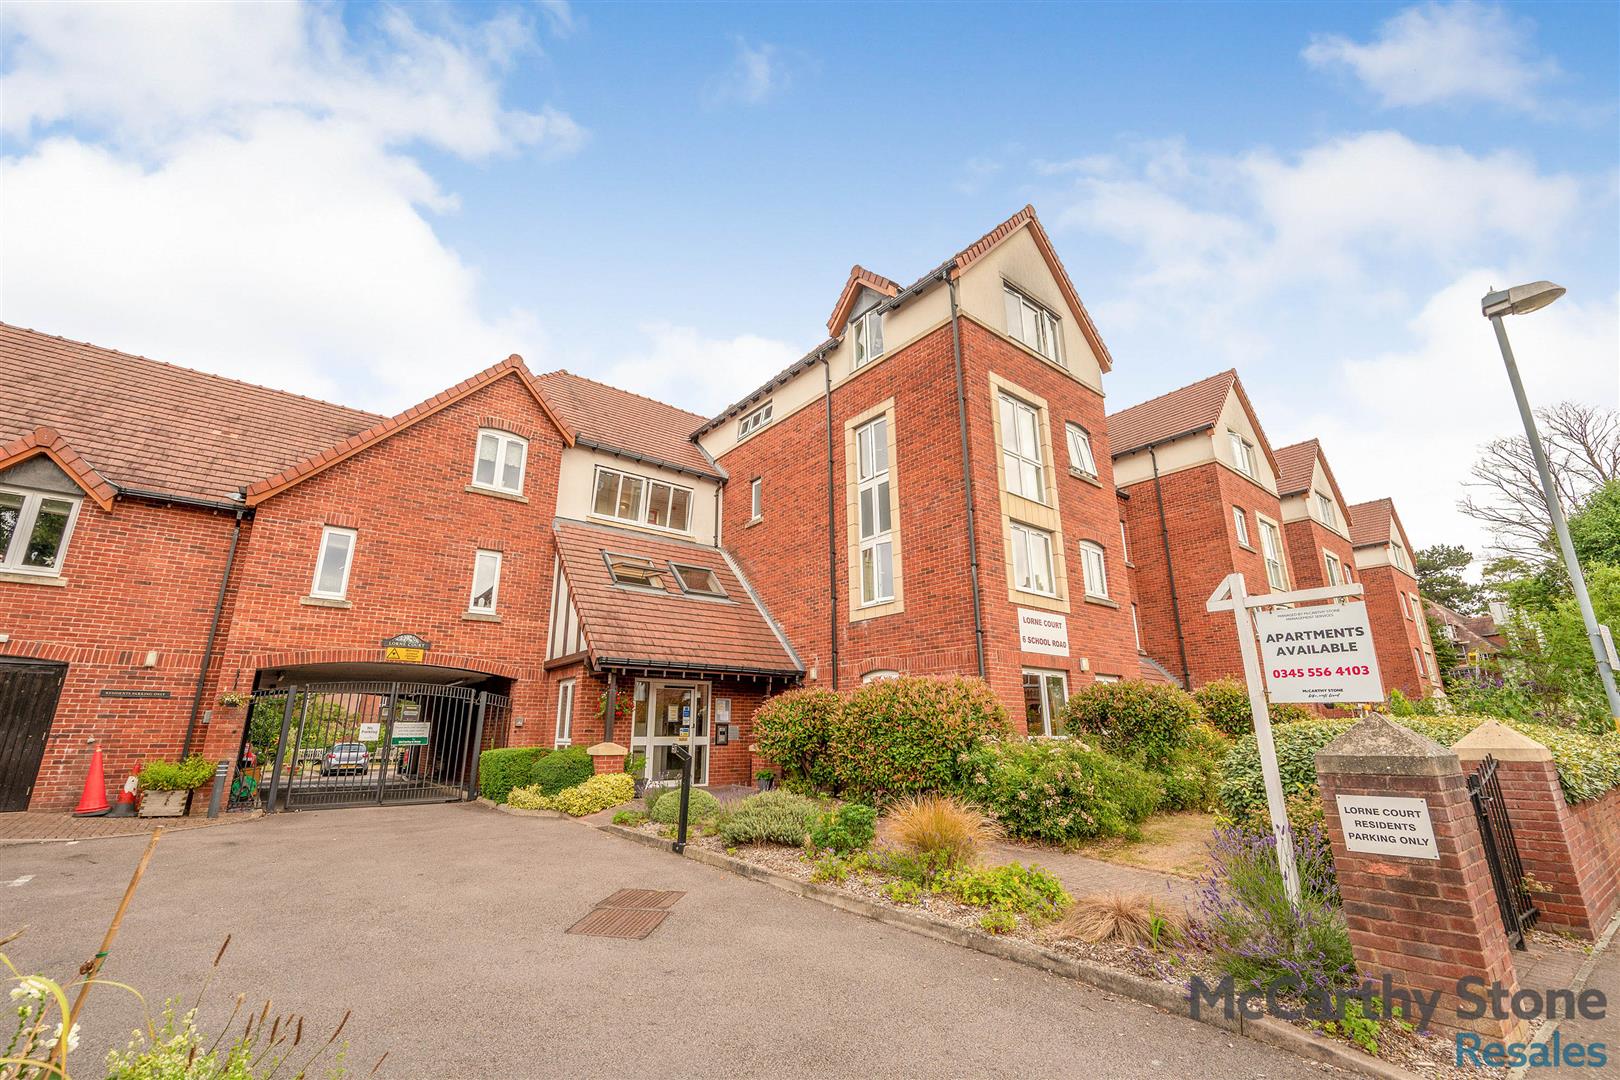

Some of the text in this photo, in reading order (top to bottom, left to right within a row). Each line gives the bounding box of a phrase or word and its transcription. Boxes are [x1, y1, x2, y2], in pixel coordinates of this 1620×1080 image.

[1022, 616, 1062, 629] LORNE COURT
[1266, 626, 1365, 643] APARTMENTS
[1022, 636, 1067, 648] 6 SCHOOL ROAD
[1276, 642, 1358, 656] AVAILABLE
[1272, 666, 1370, 678] 0345 556 4103
[1344, 806, 1422, 818] LORNE COURT
[1354, 820, 1416, 832] RESIDENTS
[1348, 832, 1428, 846] PARKING ONLY
